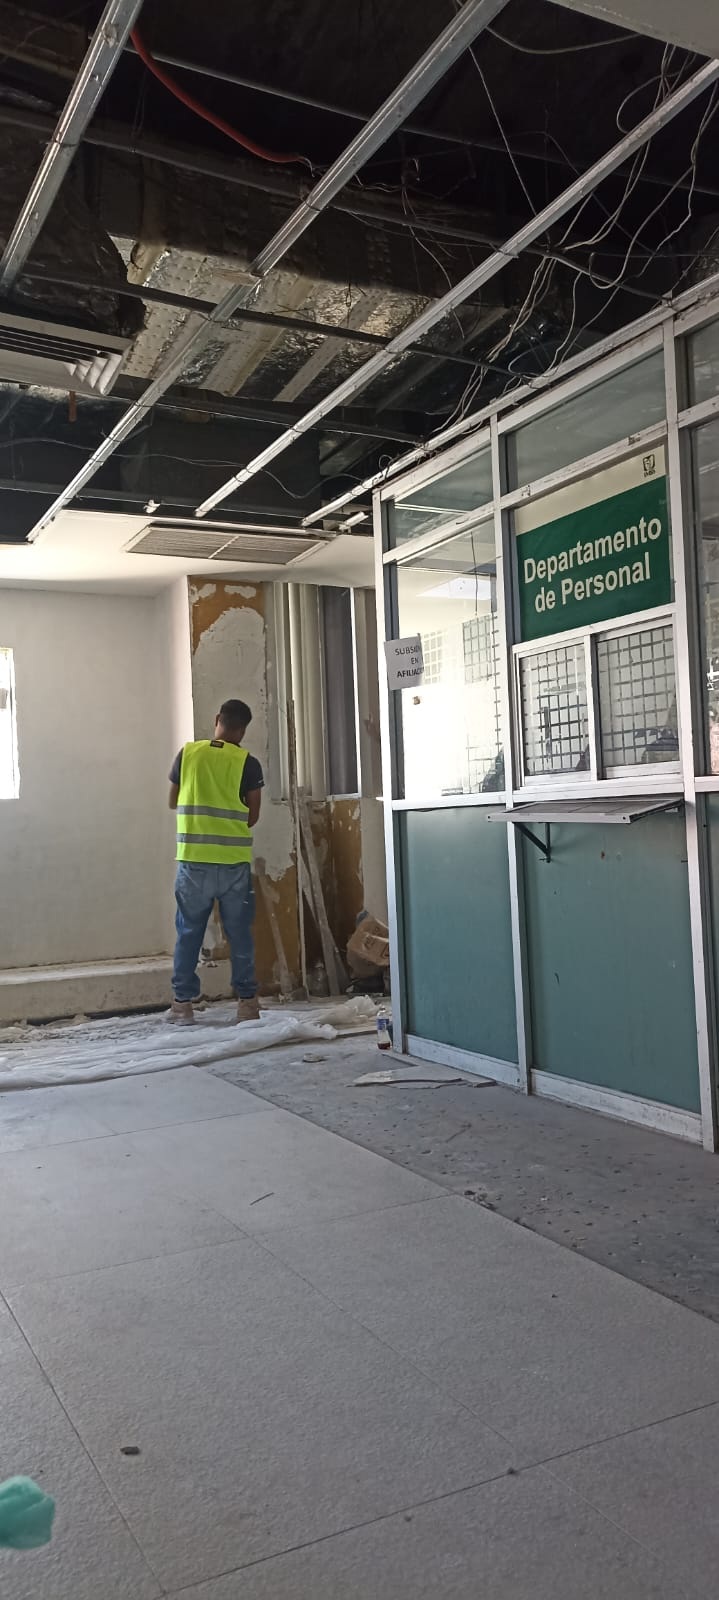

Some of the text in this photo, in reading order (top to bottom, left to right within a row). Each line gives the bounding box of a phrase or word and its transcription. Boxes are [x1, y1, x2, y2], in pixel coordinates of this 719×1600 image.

[524, 516, 662, 584] Departamento
[535, 551, 651, 613] de Personal
